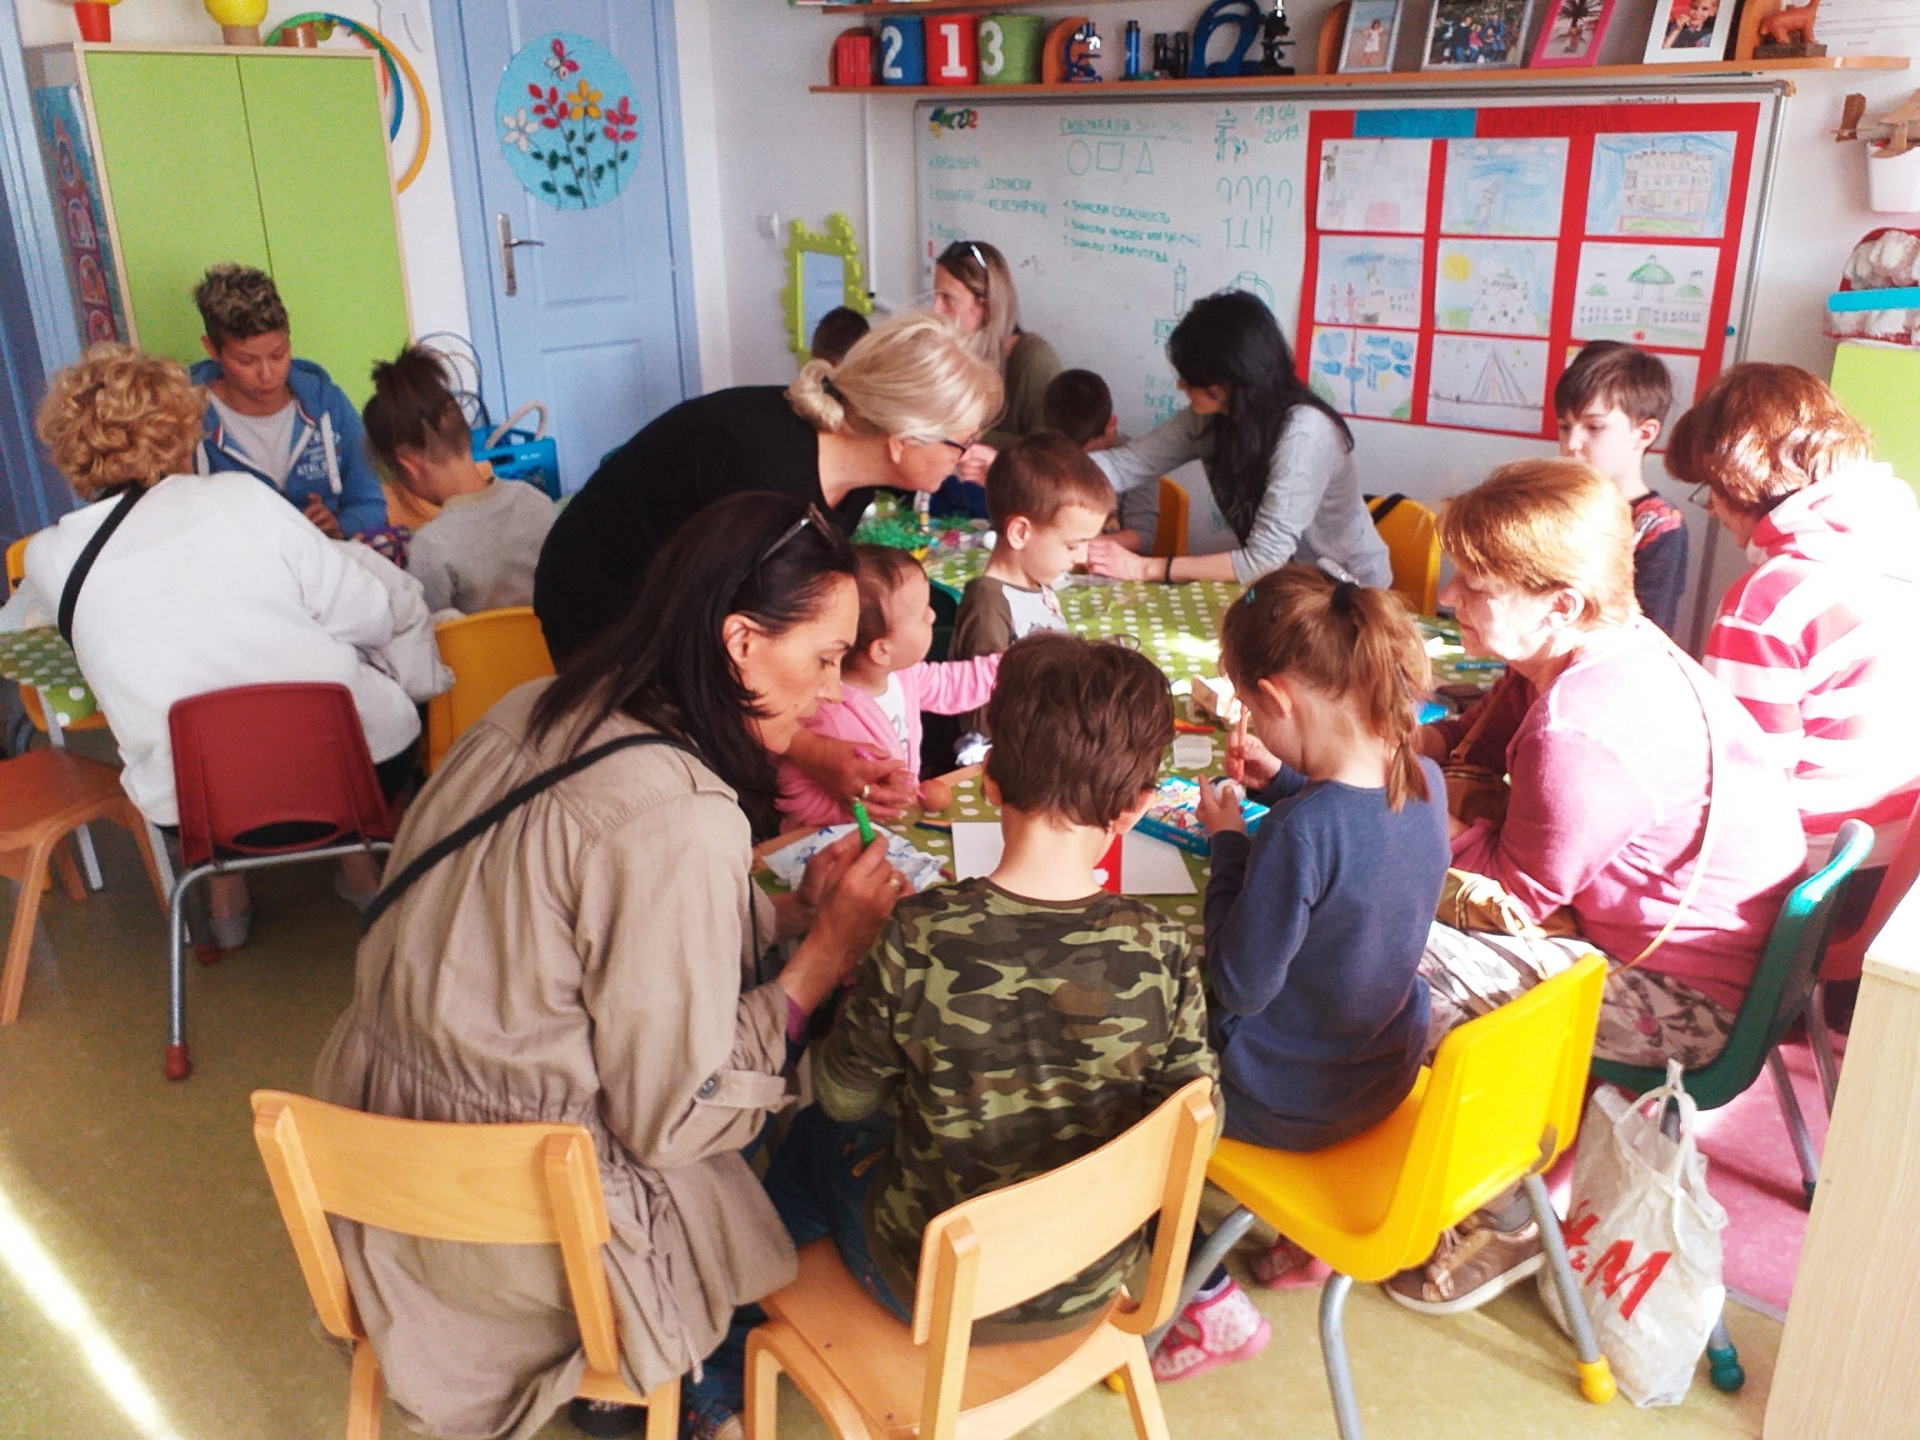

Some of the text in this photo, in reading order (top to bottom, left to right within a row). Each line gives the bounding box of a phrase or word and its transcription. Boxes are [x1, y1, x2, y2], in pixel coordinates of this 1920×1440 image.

[881, 25, 904, 79] 2
[939, 23, 968, 78] 1
[979, 19, 1005, 77] 3
[1263, 118, 1300, 139] 2019
